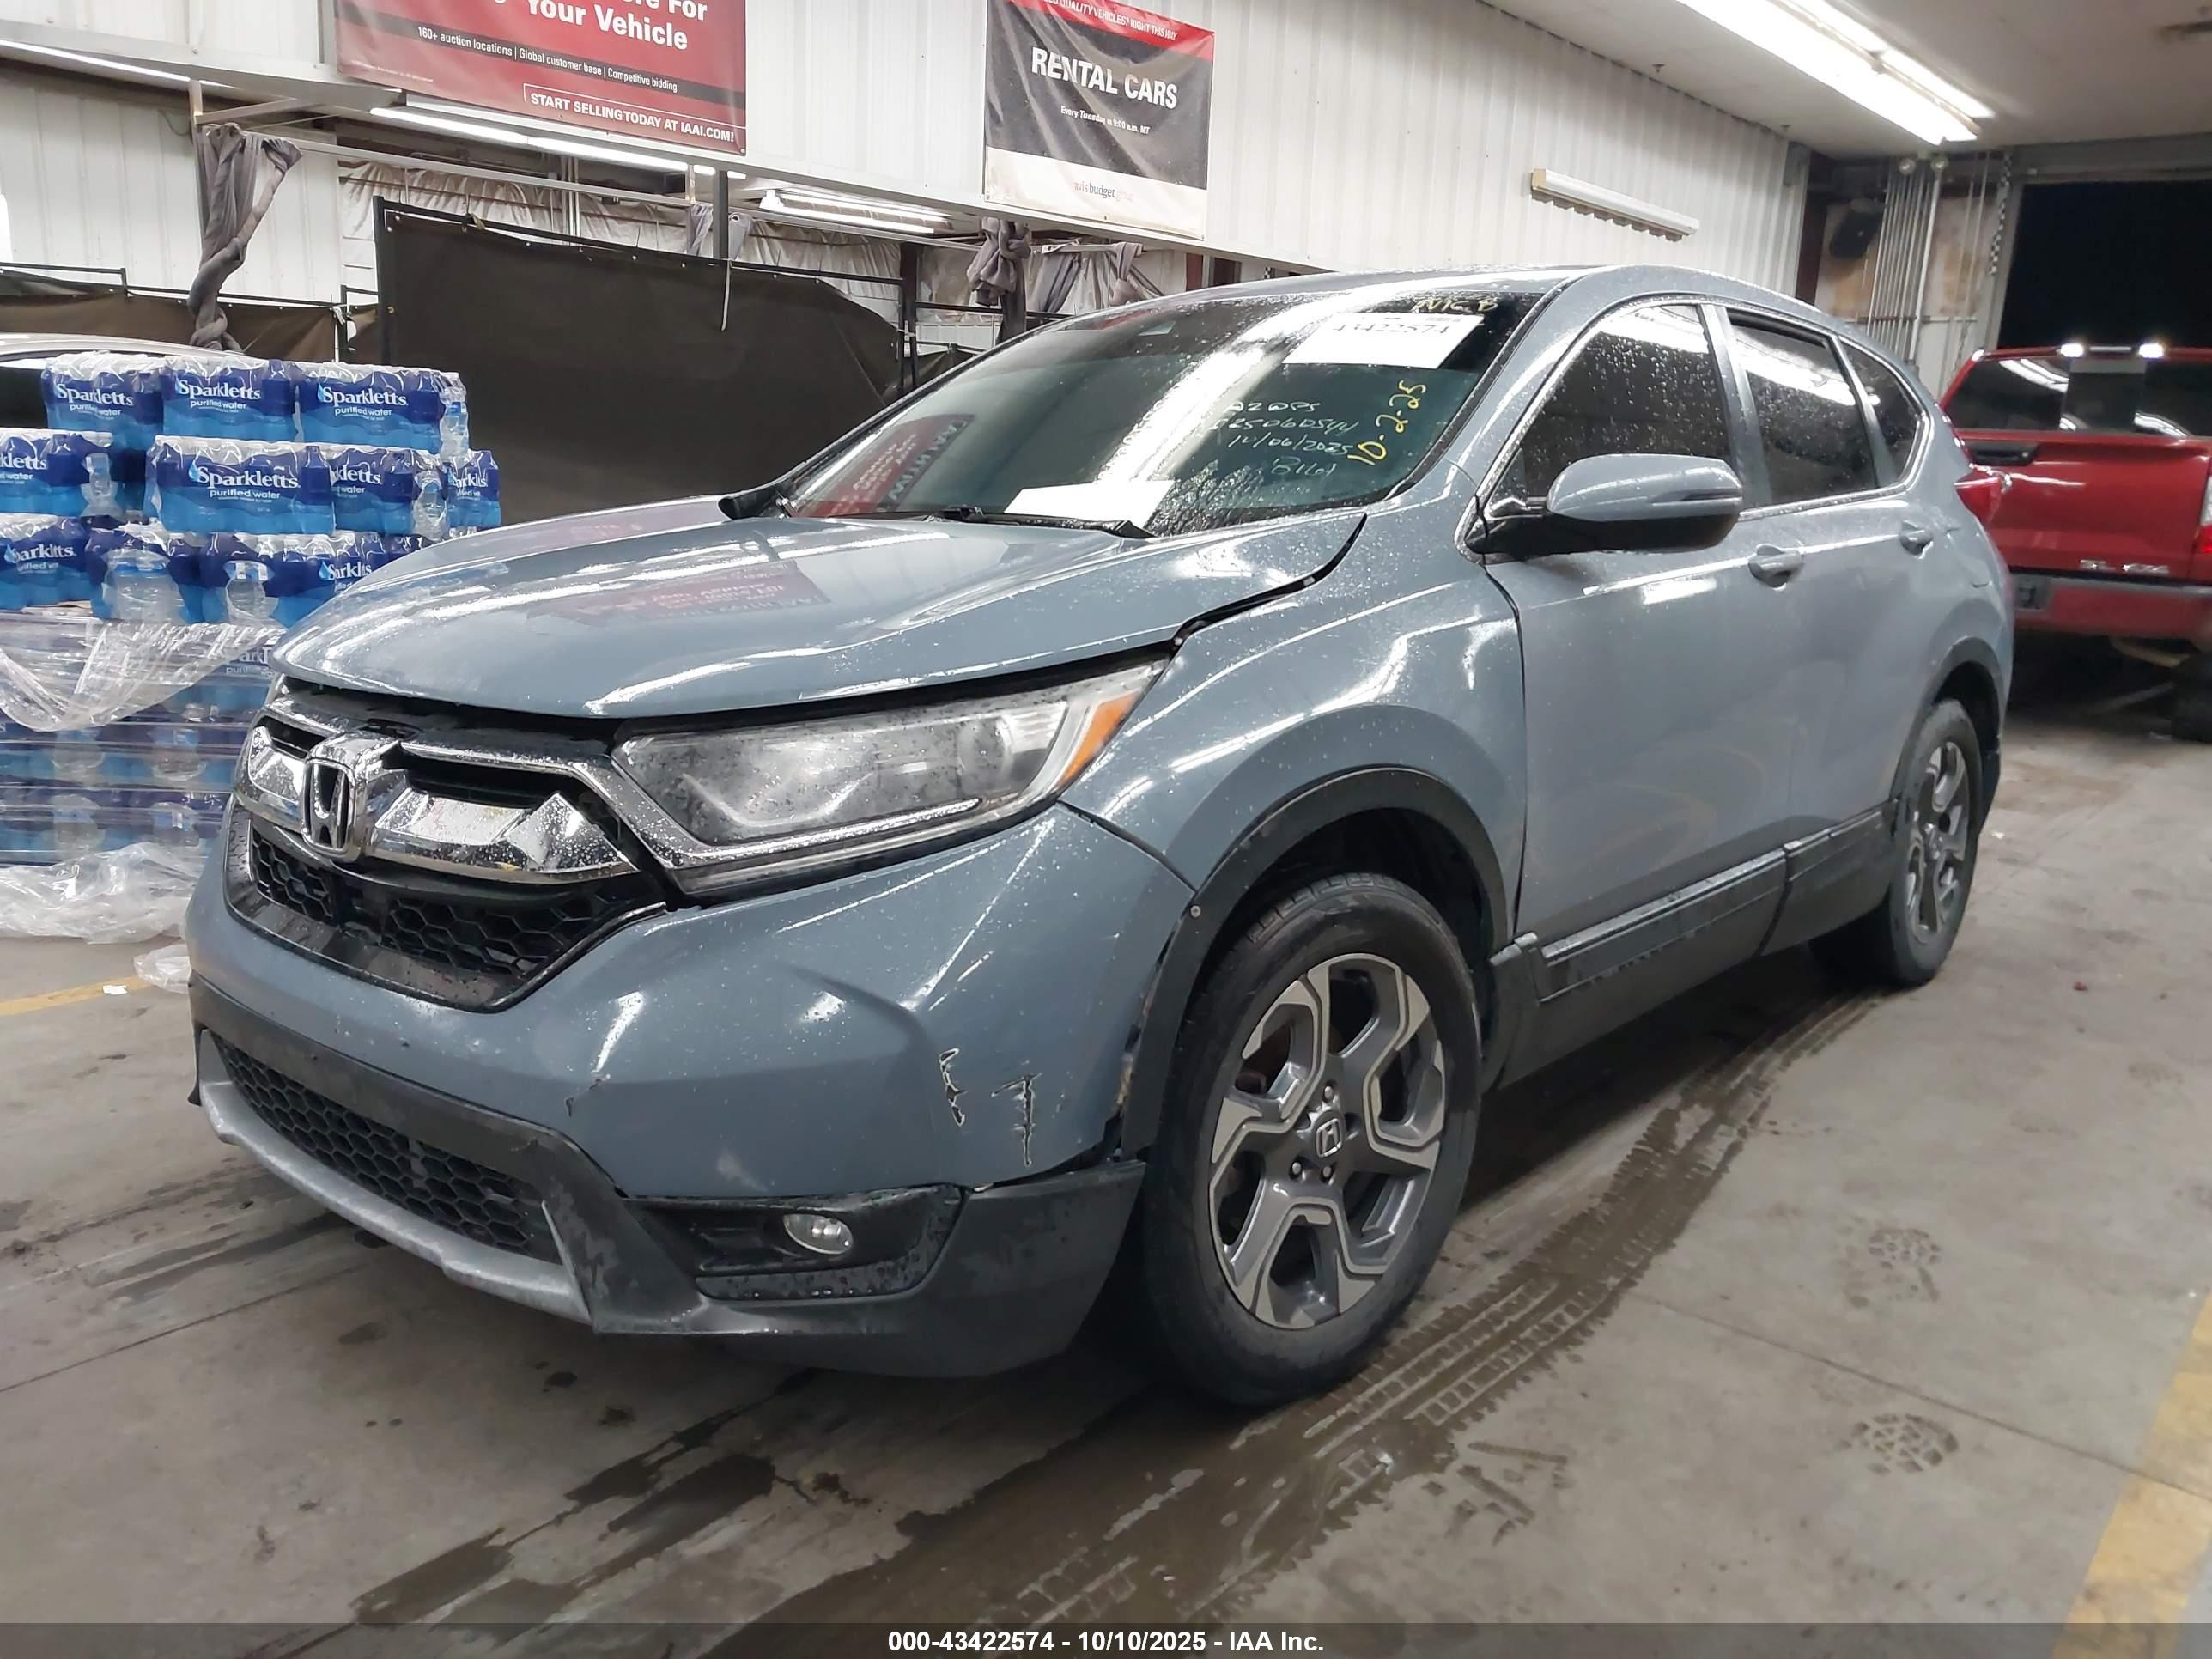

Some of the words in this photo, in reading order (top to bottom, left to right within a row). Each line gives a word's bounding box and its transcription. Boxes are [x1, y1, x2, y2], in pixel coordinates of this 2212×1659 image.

[528, 0, 586, 26] Your
[594, 4, 688, 50] Vehicle
[1130, 19, 1151, 33] RIGHT
[417, 27, 438, 40] 160+
[440, 32, 471, 47] auction
[473, 39, 513, 57] locations
[519, 47, 544, 64] Global
[546, 55, 581, 71] customer
[583, 62, 602, 76] base
[608, 68, 650, 87] Competitive
[651, 78, 678, 93] bidding
[1031, 46, 1118, 94] RENTAL
[1124, 74, 1177, 109] CARS
[530, 93, 570, 111] START
[664, 118, 678, 132] AT
[680, 122, 735, 143] IAAI.COM!
[1060, 106, 1079, 118] Every
[1089, 183, 1115, 198] budget
[57, 383, 134, 406] Sparletts
[323, 386, 408, 407] Sparkletts
[335, 406, 368, 416] purified
[368, 408, 392, 416] water
[198, 466, 299, 489] Sparkletts
[210, 489, 252, 498] purified
